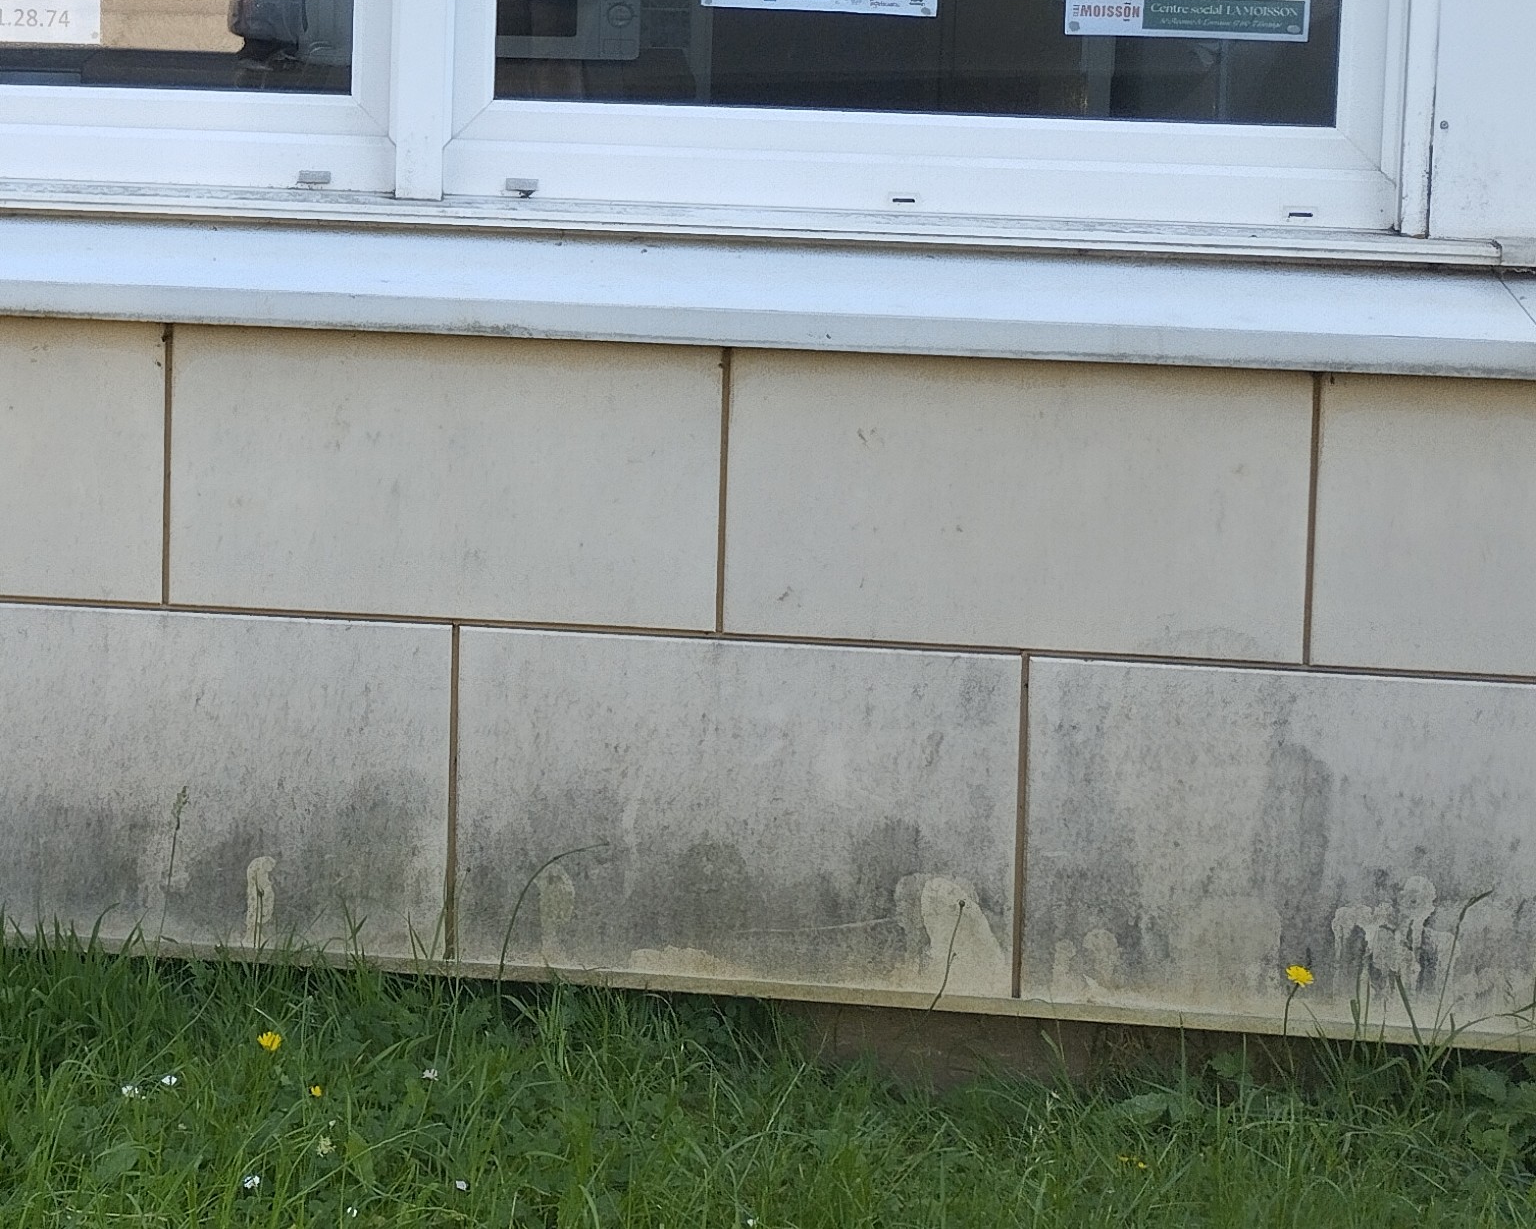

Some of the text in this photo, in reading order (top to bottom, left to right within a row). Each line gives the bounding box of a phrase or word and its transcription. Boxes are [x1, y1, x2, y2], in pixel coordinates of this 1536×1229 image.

[1079, 3, 1141, 19] MOISSON
[1150, 2, 1189, 15] Centre
[1190, 4, 1223, 15] social
[1243, 5, 1298, 18] MOISSON
